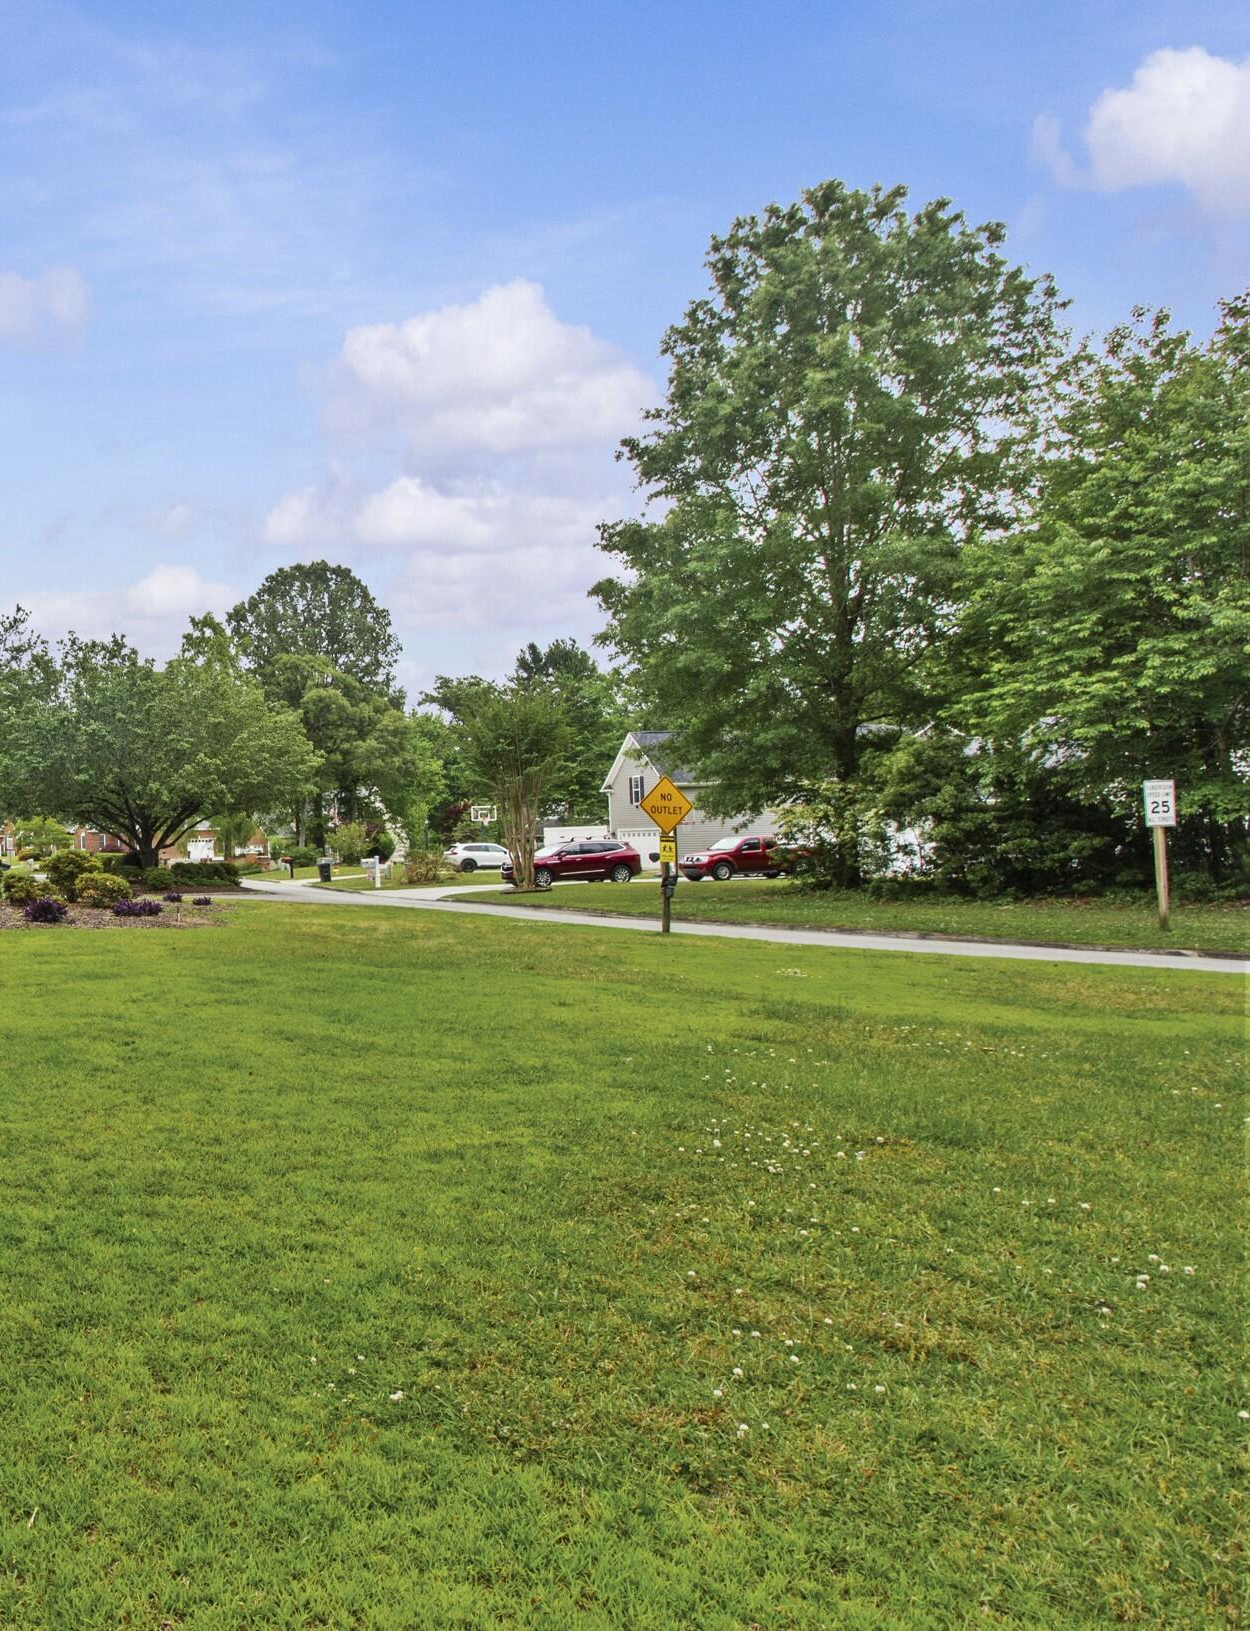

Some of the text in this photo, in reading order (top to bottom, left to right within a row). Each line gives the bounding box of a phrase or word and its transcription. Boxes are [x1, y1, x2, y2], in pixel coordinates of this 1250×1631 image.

[660, 793, 672, 802] NO
[650, 805, 683, 815] OUTLET
[1151, 801, 1170, 814] 25
